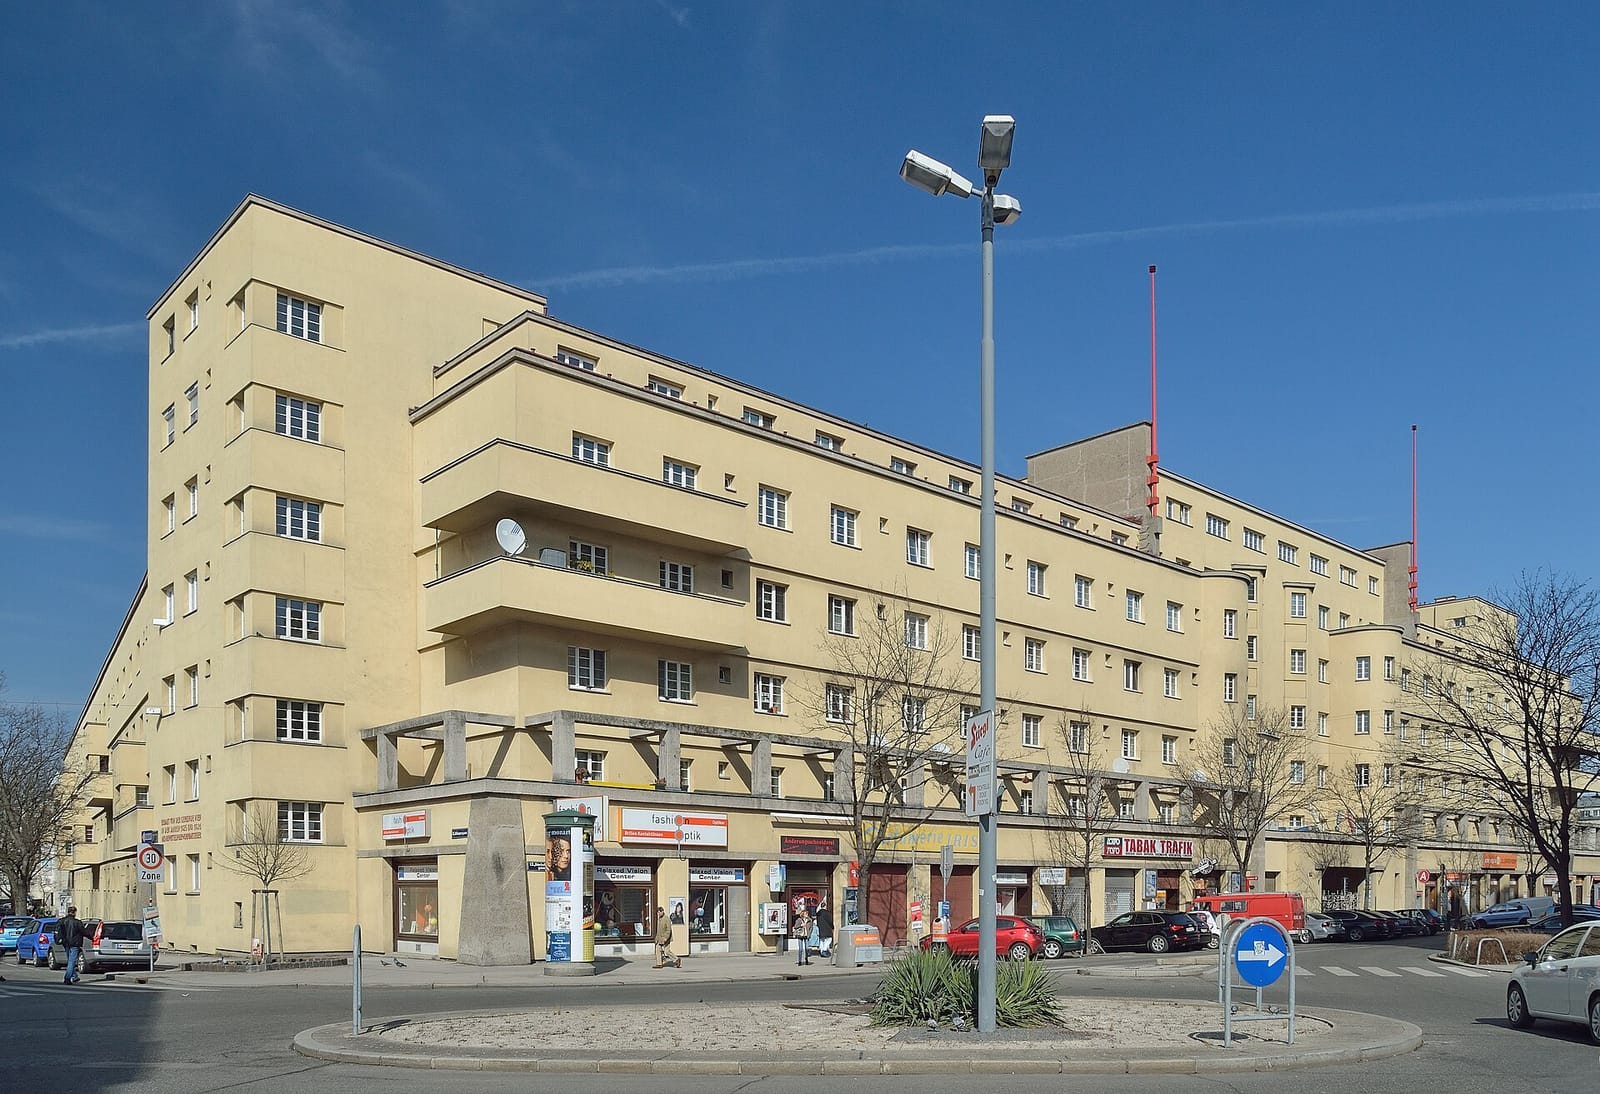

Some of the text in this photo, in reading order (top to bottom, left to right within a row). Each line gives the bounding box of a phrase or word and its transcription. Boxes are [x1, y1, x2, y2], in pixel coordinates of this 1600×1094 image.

[1124, 838, 1193, 855] TABAK TRAFIK
[145, 853, 156, 864] 30
[141, 870, 161, 880] Zone
